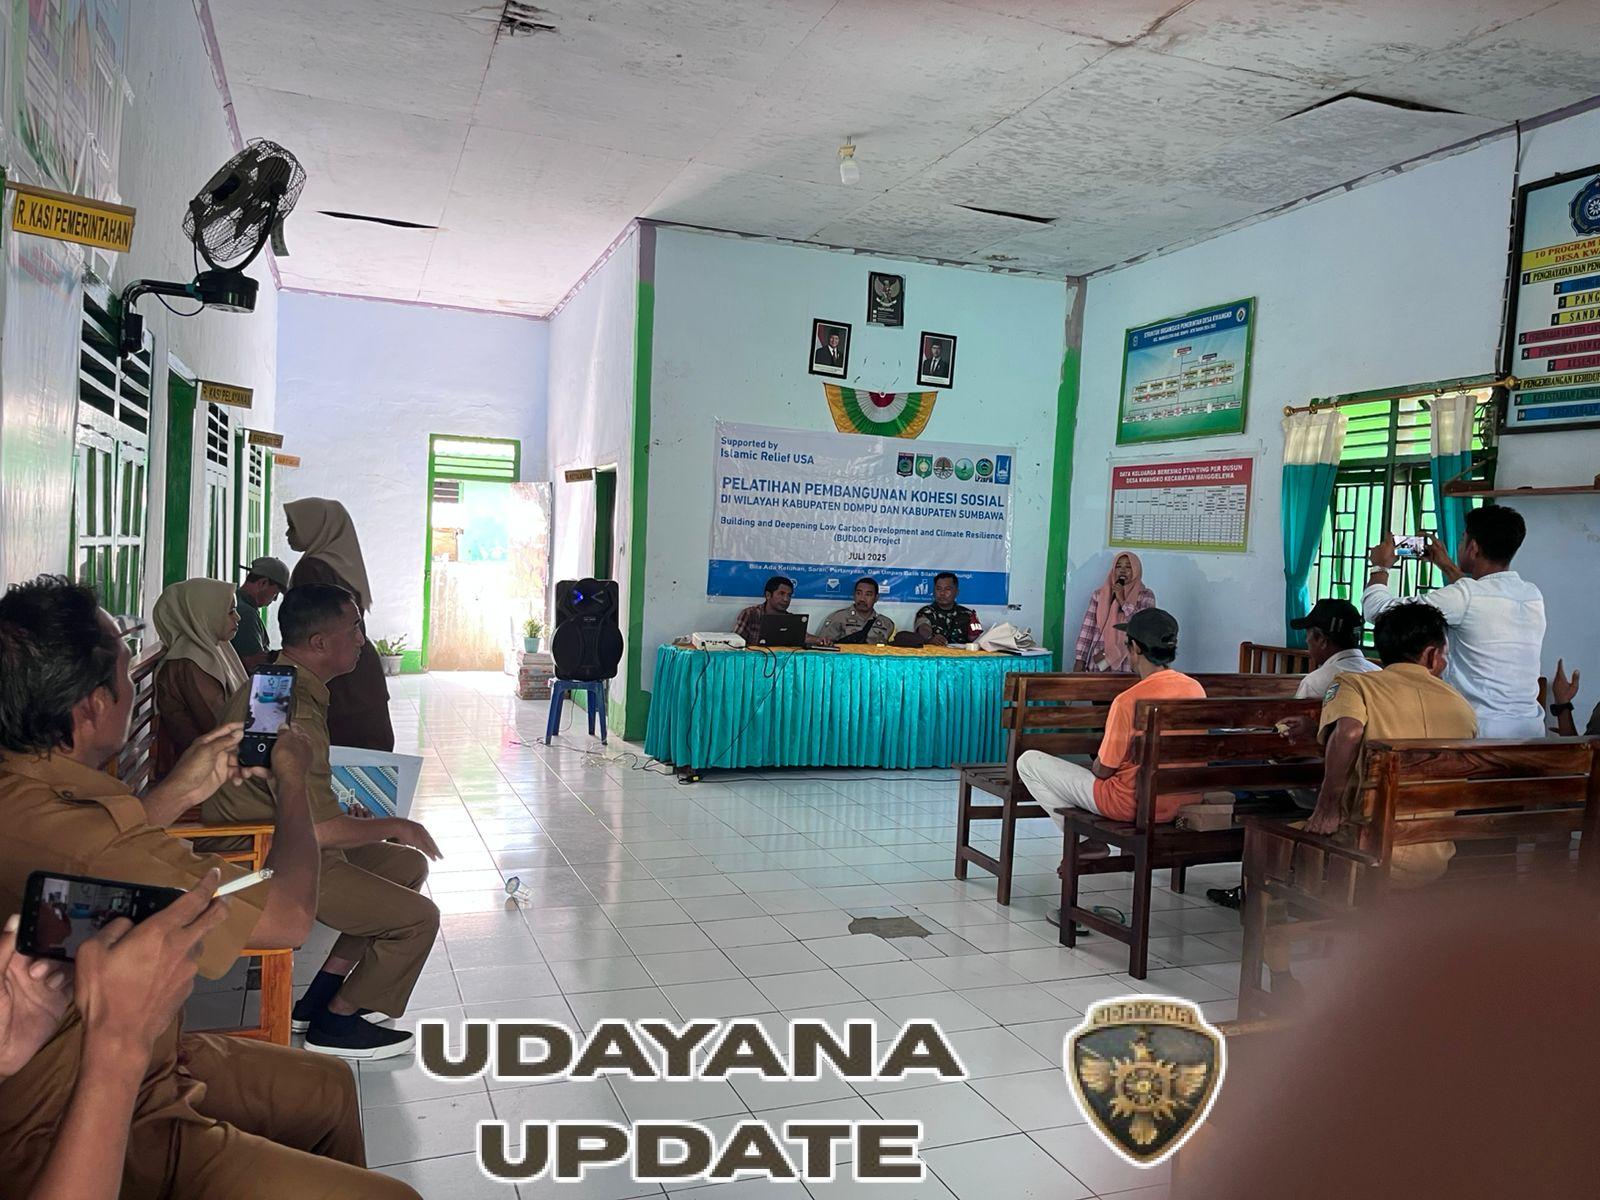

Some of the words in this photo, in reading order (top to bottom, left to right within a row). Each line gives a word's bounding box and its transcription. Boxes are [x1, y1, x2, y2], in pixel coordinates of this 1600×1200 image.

[16, 199, 26, 225] R.
[29, 202, 54, 230] KASI
[54, 208, 130, 246] PEMERINTAHAN
[1548, 240, 1595, 256] PROGRAM
[1555, 252, 1579, 262] DESA
[1583, 248, 1600, 257] KW
[1573, 264, 1586, 274] DAN
[720, 436, 766, 449] Supported
[768, 441, 778, 451] by
[720, 448, 758, 460] Islamic
[761, 451, 791, 463] Relief
[793, 455, 815, 465] USA
[1183, 466, 1209, 474] STUNTING
[722, 477, 801, 495] PELATIHAN
[804, 483, 907, 501] PEMBANGUNAN
[911, 491, 957, 504] KOHESI
[961, 494, 1005, 507] SOSIAL
[721, 494, 731, 504] DI
[733, 495, 780, 507] WILAYAH
[782, 498, 841, 511] KABUPATEN
[843, 502, 878, 514] DOMPU
[880, 504, 900, 514] DAN
[902, 506, 957, 518] KABUPATEN
[959, 510, 1004, 520] SUMBAWA
[720, 517, 755, 527] Building
[758, 519, 773, 527] and
[775, 520, 818, 531] Deepening
[820, 523, 836, 531] Low
[838, 524, 867, 532] Carbon
[868, 526, 919, 535] Development
[936, 529, 964, 538] Climate
[965, 531, 1003, 540] Resilience
[834, 534, 871, 544] (BUDLOC)
[873, 536, 901, 546] Project
[848, 552, 866, 561] JULI
[868, 553, 887, 561] 2025
